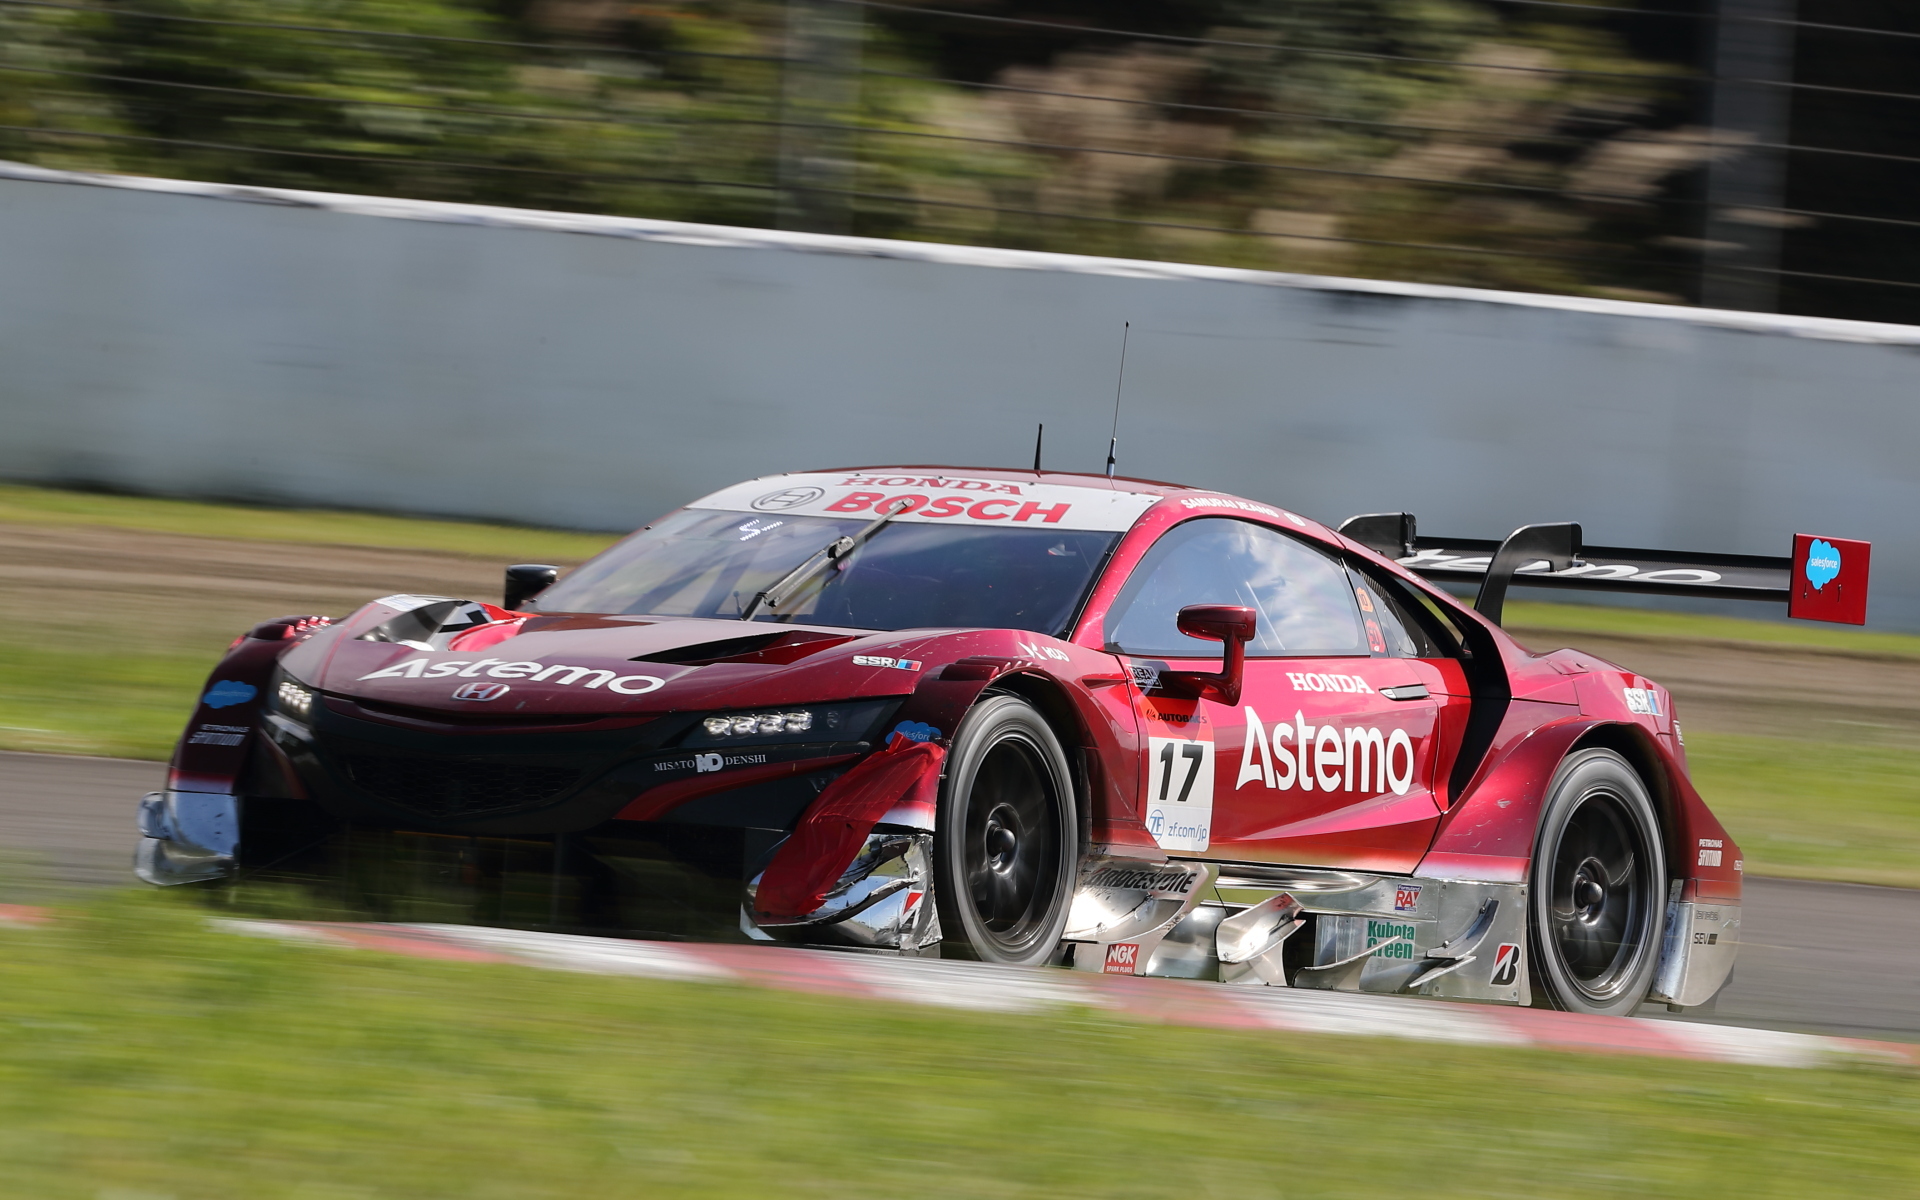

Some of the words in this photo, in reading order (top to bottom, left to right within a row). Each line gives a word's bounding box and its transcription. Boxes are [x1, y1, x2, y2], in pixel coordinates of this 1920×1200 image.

[836, 477, 1023, 496] HONDA
[824, 491, 1072, 524] BOSCH
[1180, 498, 1238, 509] SAMURAI
[1235, 501, 1279, 518] JEANS
[1811, 556, 1838, 571] salesforce
[852, 655, 896, 668] SSR
[356, 658, 667, 695] Astemo
[1285, 672, 1375, 695] HONDA
[1624, 687, 1651, 715] SSR
[1157, 712, 1208, 724] AUTOBACS
[1235, 705, 1414, 796] Astemo
[653, 760, 695, 771] MISATO
[725, 754, 767, 765] DENSHI
[1159, 742, 1204, 803] 17
[1168, 822, 1208, 842] zf.com/jp
[1698, 838, 1723, 849] PETRONAS
[1083, 867, 1198, 894] BRIDGESTONE
[1367, 920, 1415, 940] Kubota
[1693, 932, 1709, 945] SEV
[1108, 945, 1136, 964] NGK
[1367, 938, 1413, 960] Green
[1119, 966, 1133, 974] PLUGS
